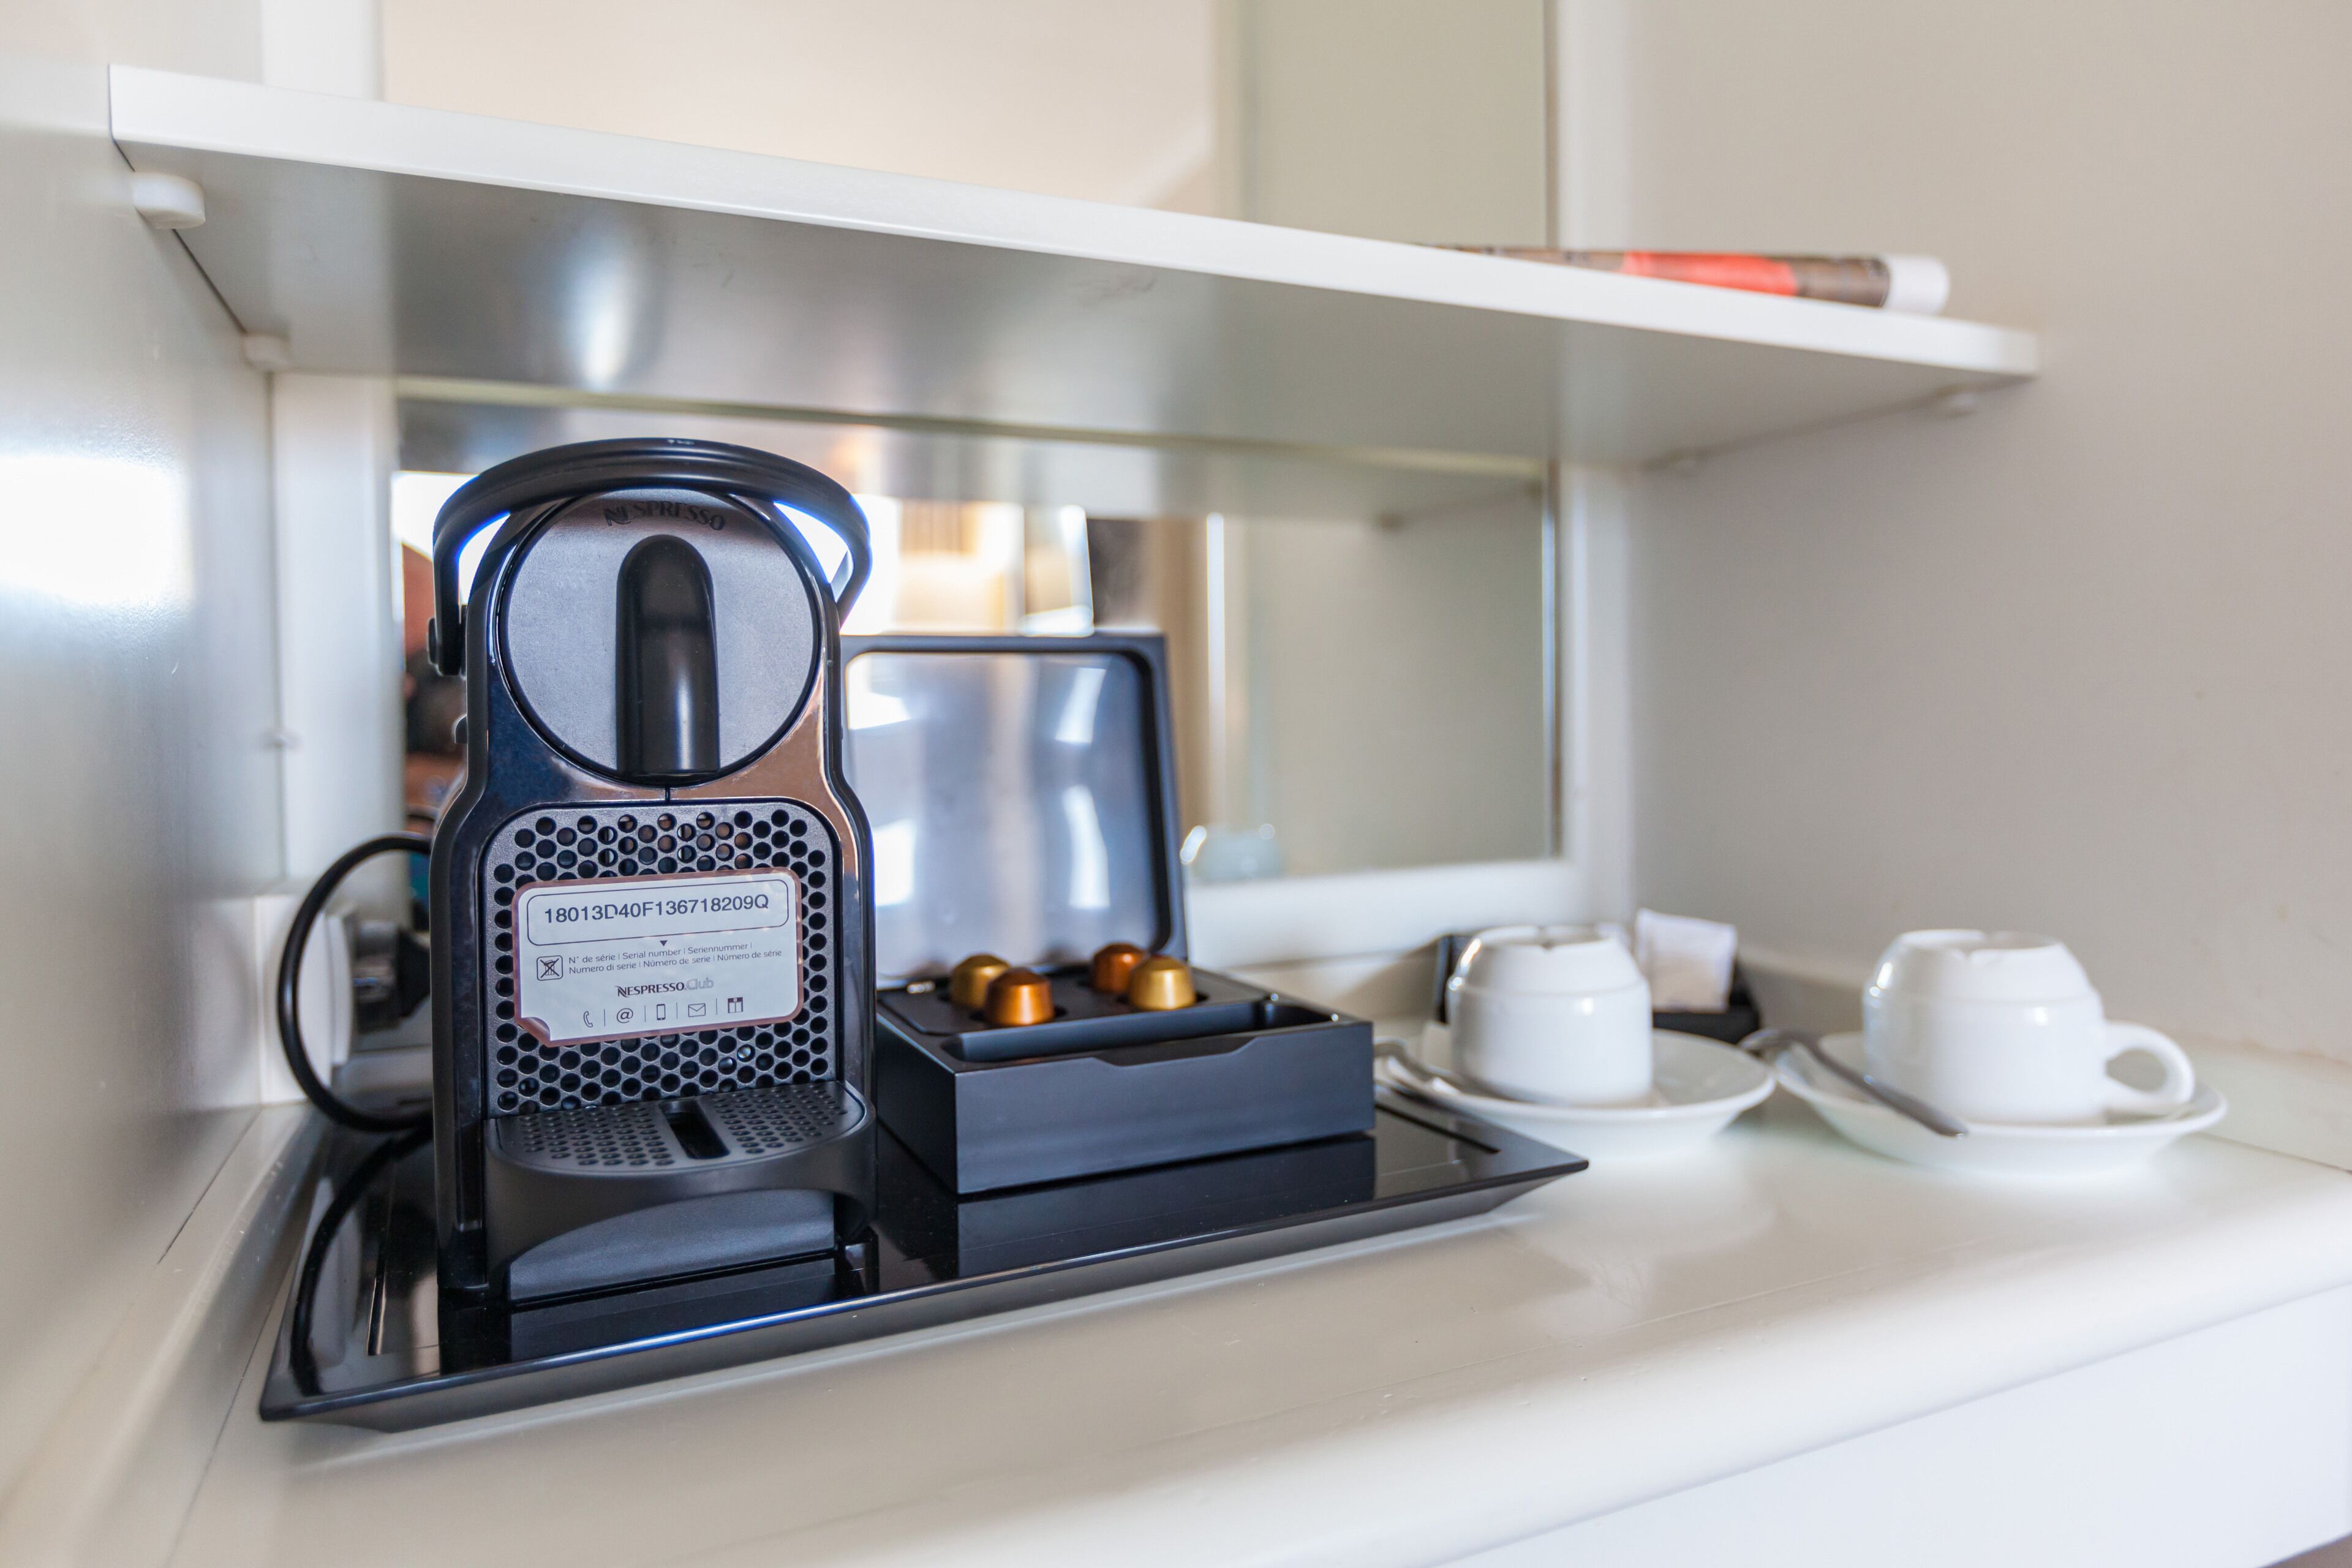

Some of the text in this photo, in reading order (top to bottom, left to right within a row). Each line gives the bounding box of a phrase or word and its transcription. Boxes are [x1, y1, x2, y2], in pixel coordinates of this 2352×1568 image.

[545, 894, 769, 923] 18013D40F136718209Q
[623, 951, 646, 959] Serial
[688, 943, 748, 954] Seriennummer
[569, 964, 604, 974] Numero
[643, 957, 677, 967] Número
